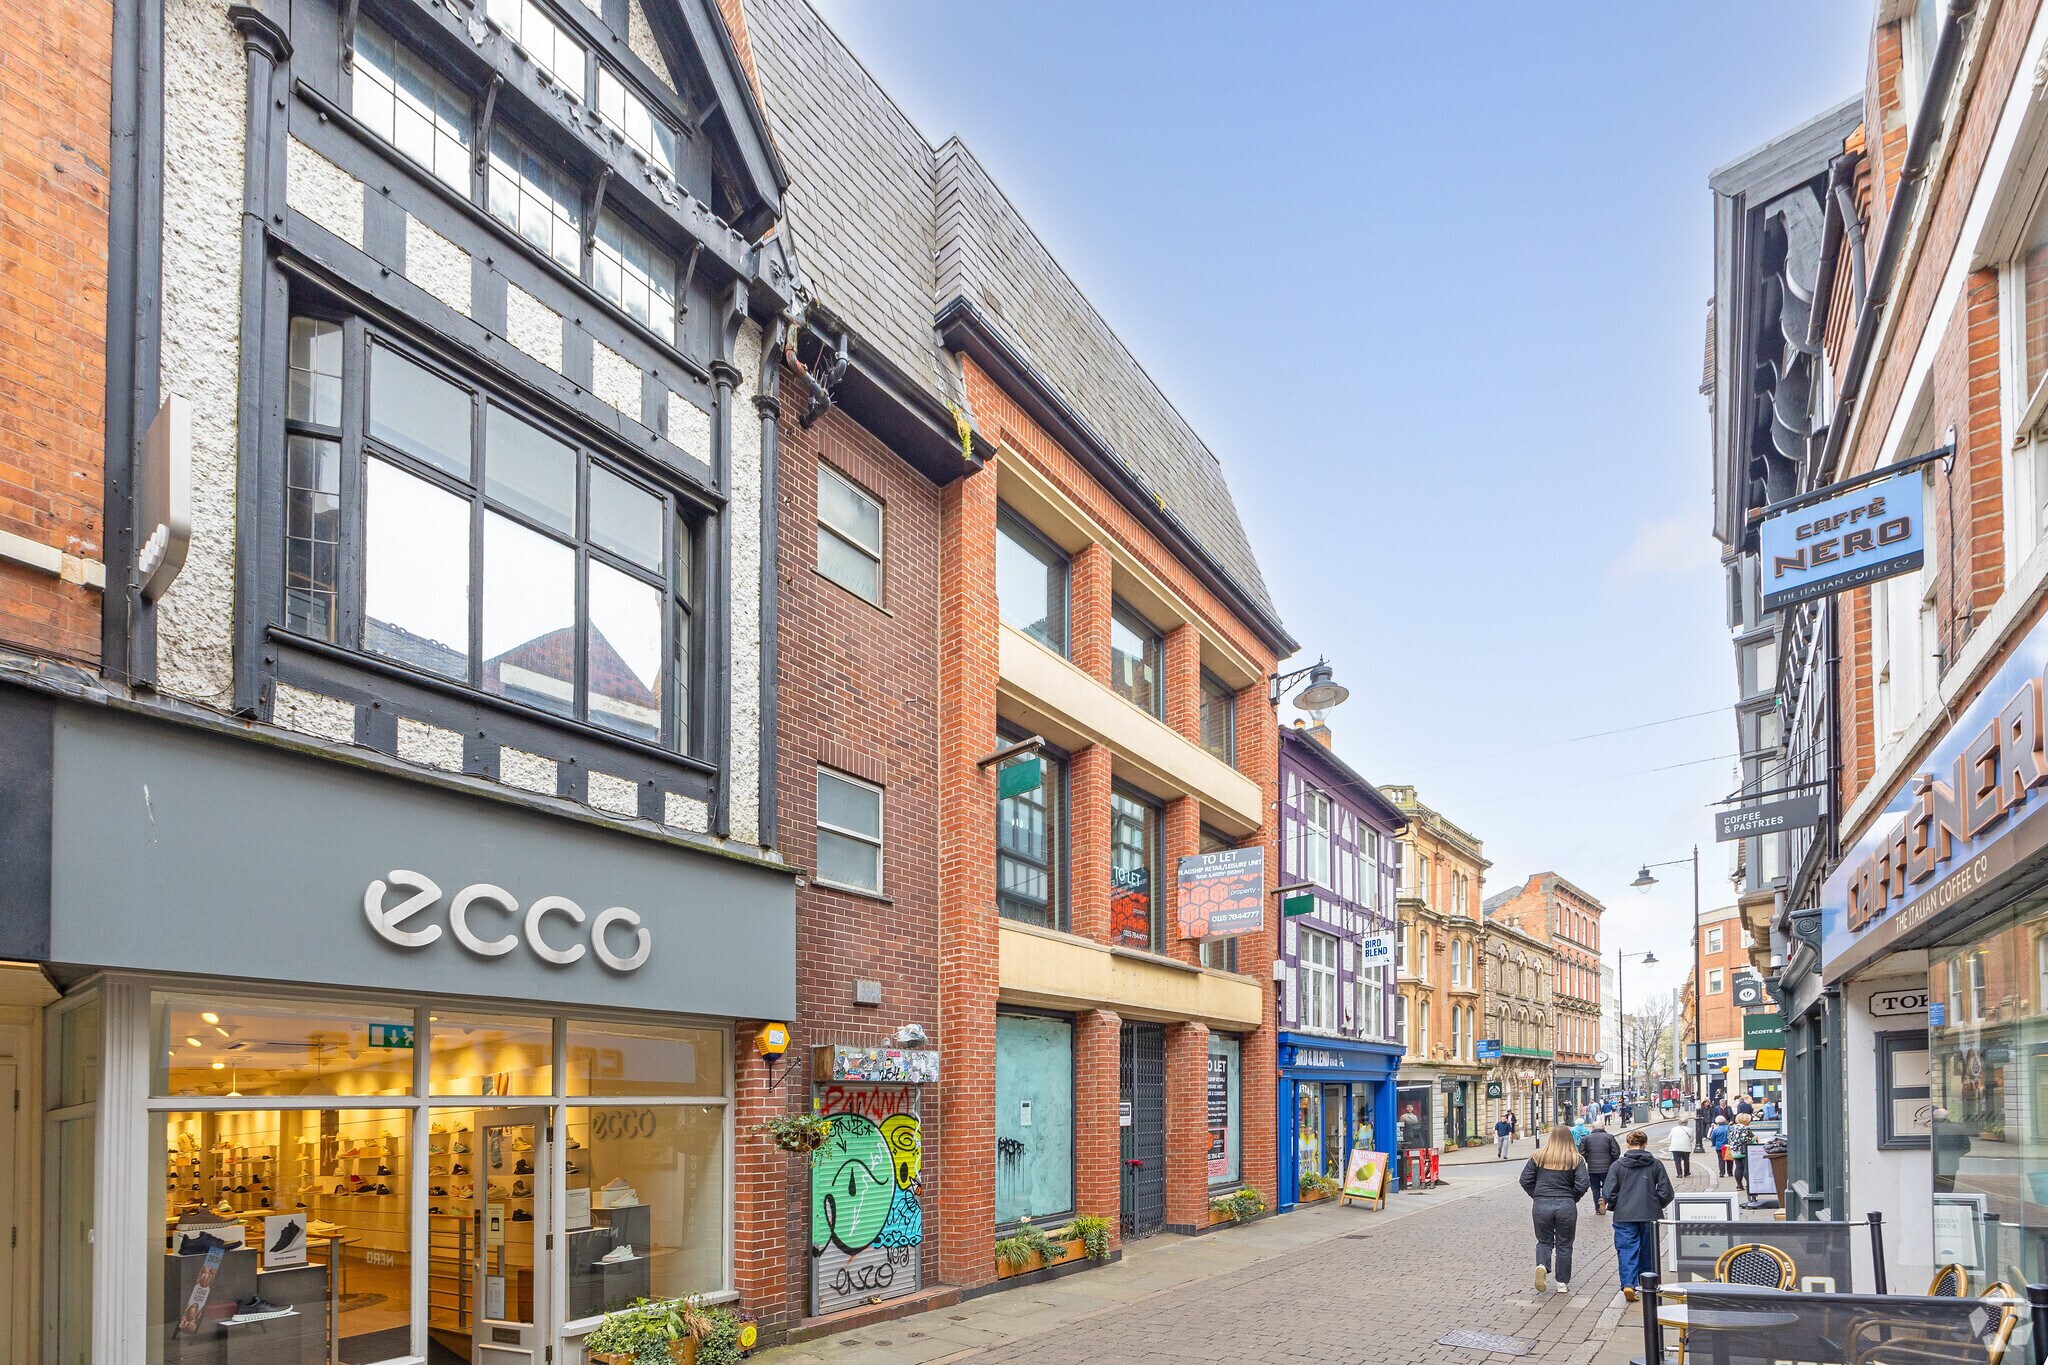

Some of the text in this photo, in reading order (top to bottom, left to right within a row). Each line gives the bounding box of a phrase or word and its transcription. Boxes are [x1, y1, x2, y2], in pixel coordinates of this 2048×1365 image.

[1796, 497, 1887, 541] CAFFÈ
[1774, 516, 1912, 579] NERO
[1778, 593, 1796, 603] THE
[1800, 578, 1844, 597] ITALIAN
[1847, 564, 1889, 582] COFFEE
[1932, 661, 2048, 864] NER
[1724, 811, 1761, 825] COFFEE
[1724, 816, 1784, 834] & PASTRIES
[1202, 851, 1239, 865] TO LET
[1113, 866, 1142, 887] TO LET
[1178, 867, 1204, 876] FLAGSHIP
[1248, 859, 1262, 867] UNIT
[1230, 887, 1257, 897] property
[1895, 914, 1908, 935] THE
[1908, 892, 1937, 929] ITALIAN
[1939, 866, 1972, 906] COFFEE
[364, 869, 651, 971] ecco
[1365, 938, 1382, 949] BIRD
[1365, 946, 1388, 958] BLEND
[1214, 1060, 1226, 1073] LET
